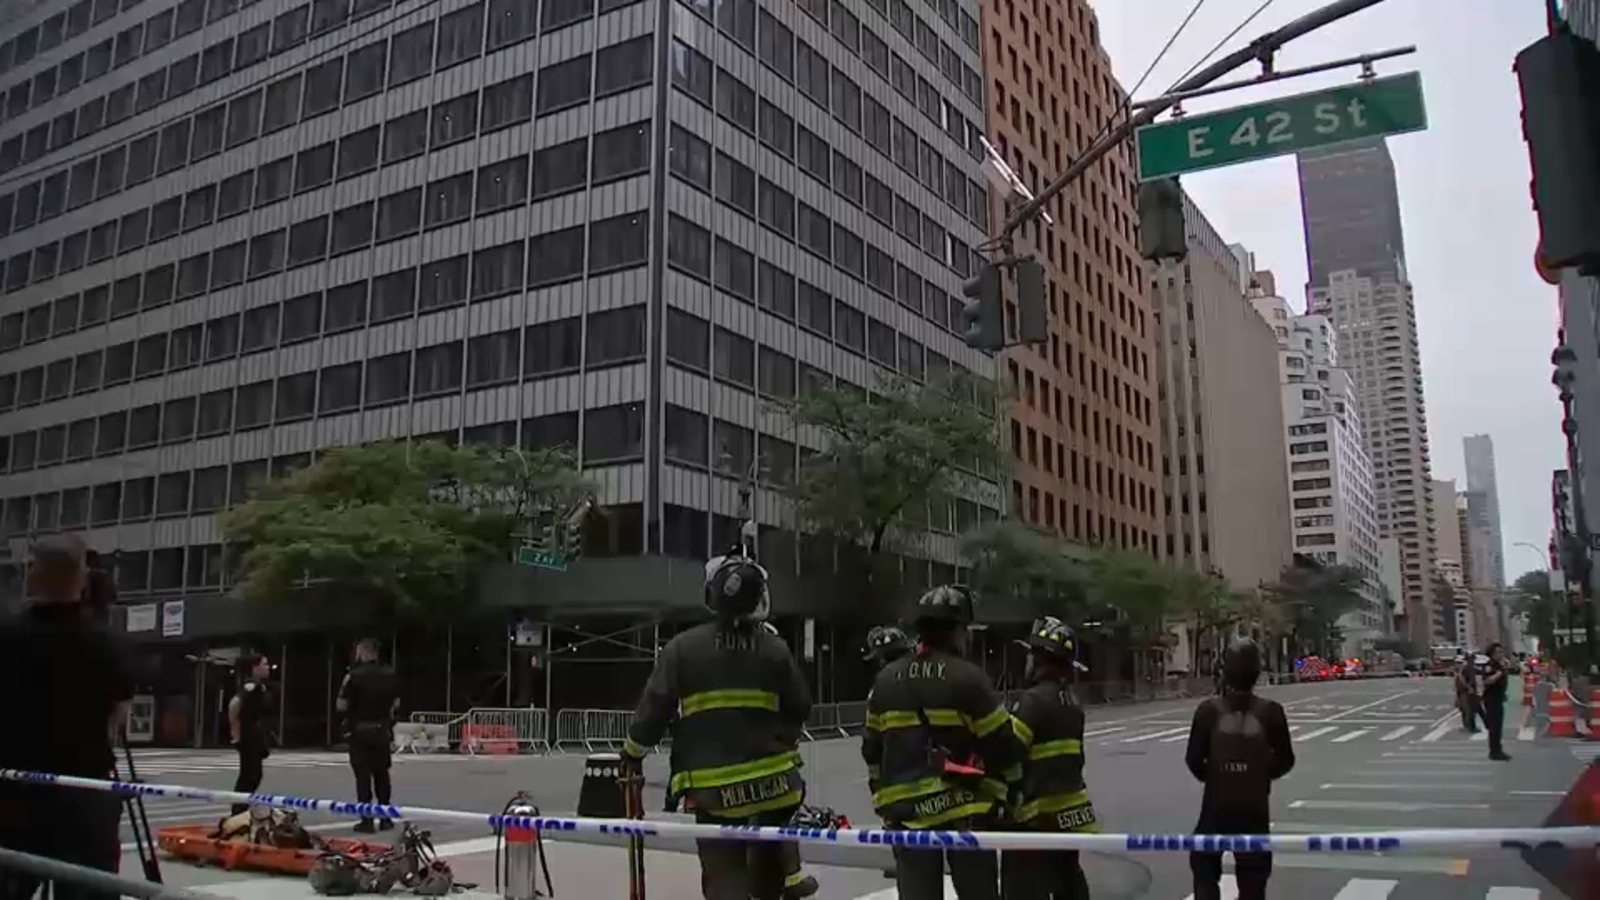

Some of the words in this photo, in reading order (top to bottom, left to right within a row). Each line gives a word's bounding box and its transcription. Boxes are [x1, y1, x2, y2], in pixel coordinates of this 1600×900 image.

[1187, 126, 1214, 158] E
[1230, 111, 1294, 147] 42
[1314, 97, 1367, 133] St
[534, 552, 541, 563] 2
[721, 775, 789, 807] MULLIGAN
[913, 789, 975, 818] ANDREWS
